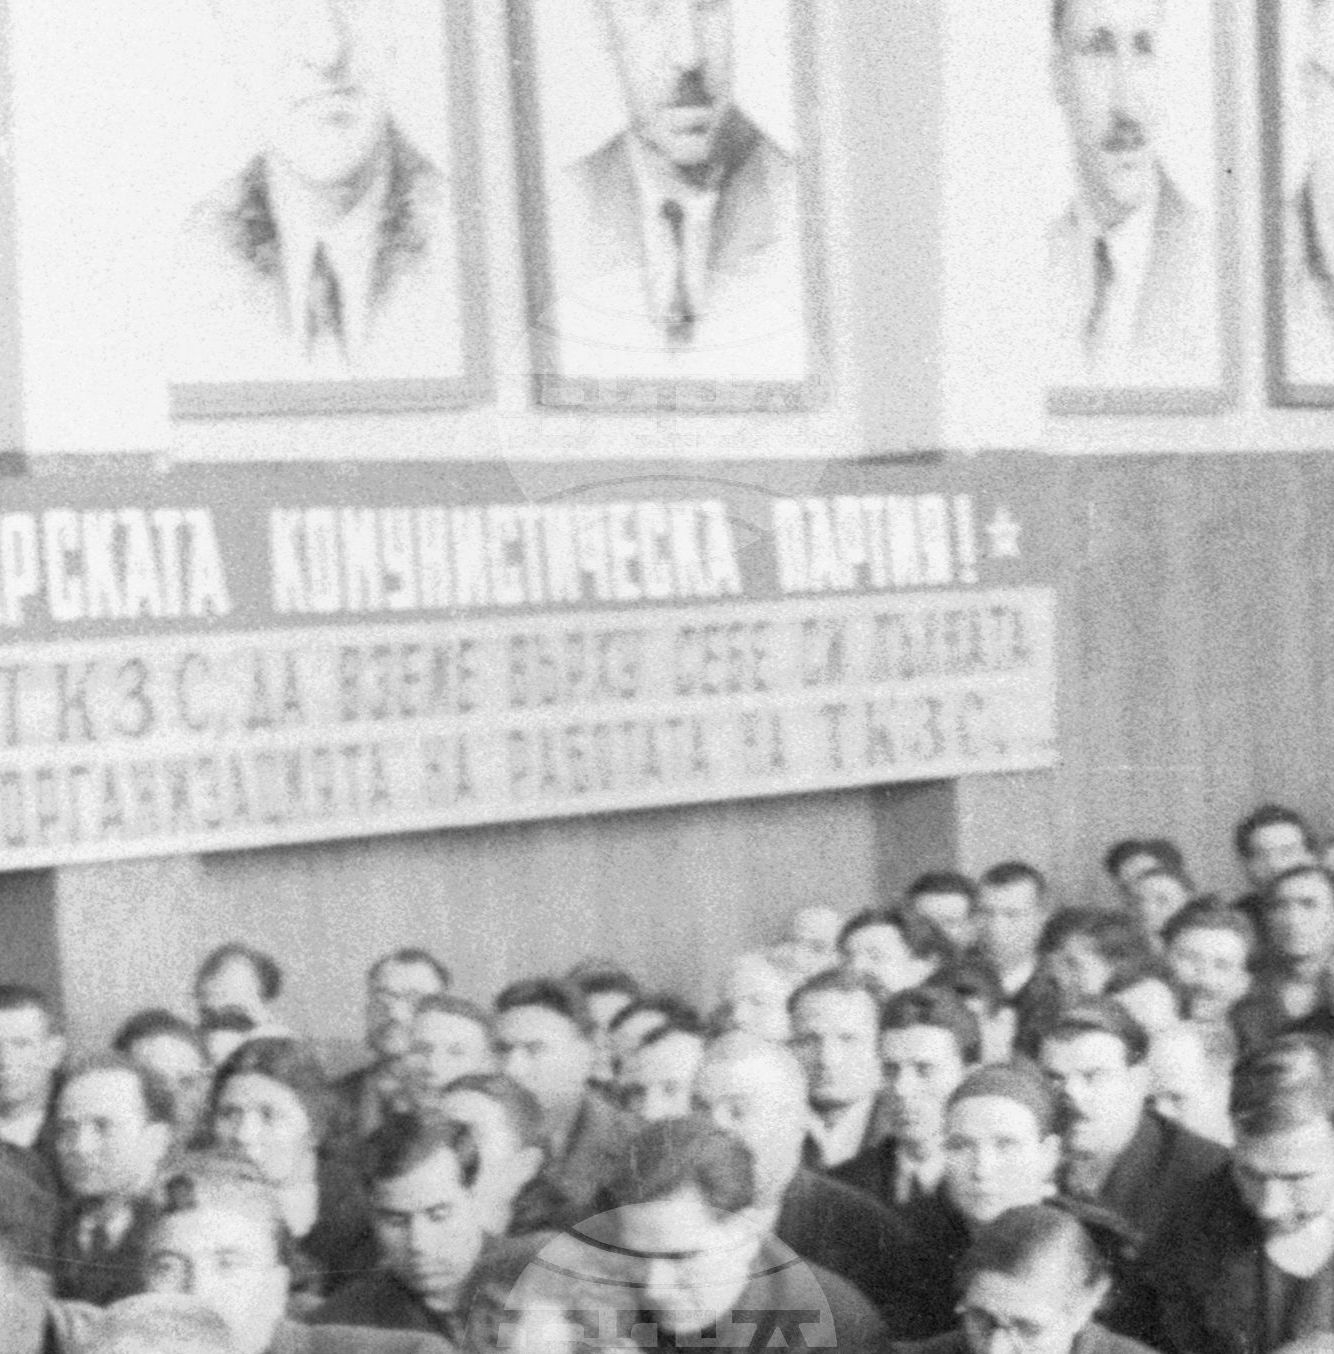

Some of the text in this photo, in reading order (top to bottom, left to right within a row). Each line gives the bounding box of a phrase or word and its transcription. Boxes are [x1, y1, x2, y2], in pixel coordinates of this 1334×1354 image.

[271, 501, 743, 612] КОМУНИСТИЧЕСКА
[772, 493, 979, 593] ПАРТИЯ!
[243, 650, 305, 731] ДА
